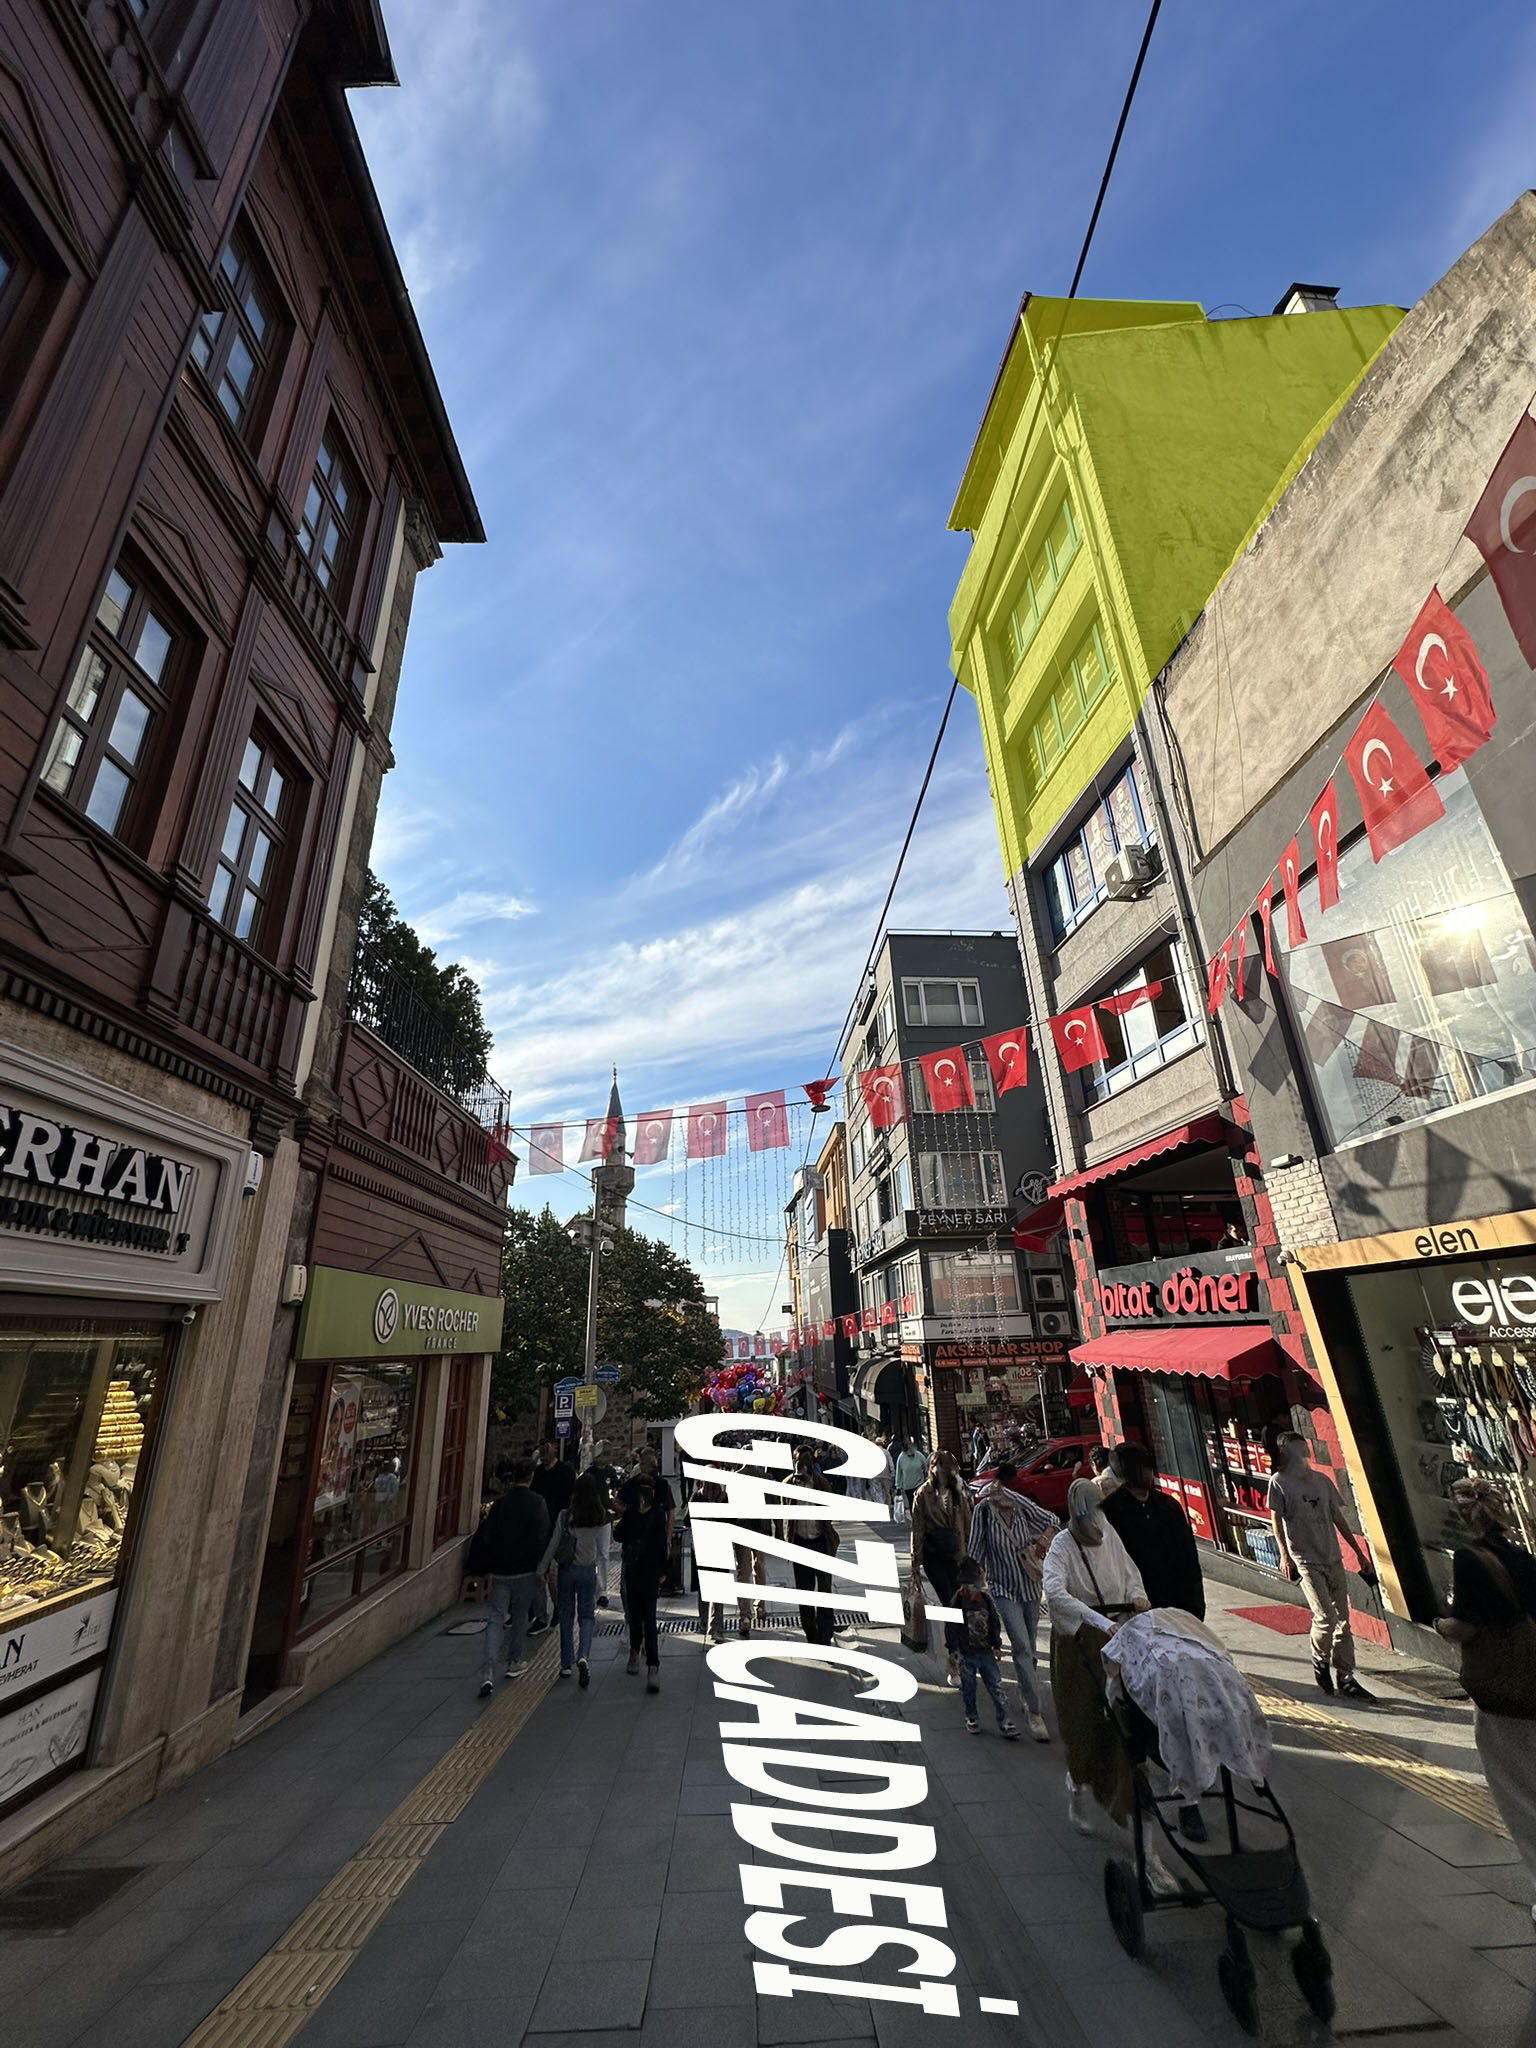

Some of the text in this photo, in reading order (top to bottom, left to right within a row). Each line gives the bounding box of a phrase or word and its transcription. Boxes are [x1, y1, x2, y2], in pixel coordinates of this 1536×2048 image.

[975, 1213, 1008, 1225] SARI
[1415, 1227, 1479, 1257] elen
[1101, 1267, 1251, 1317] bitat döner
[403, 1303, 479, 1333] YVES ROCHER
[425, 1337, 458, 1350] FRANCE
[935, 1343, 1019, 1358] AKSESUAR
[1020, 1341, 1064, 1355] SHOP
[0, 1634, 26, 1670] N
